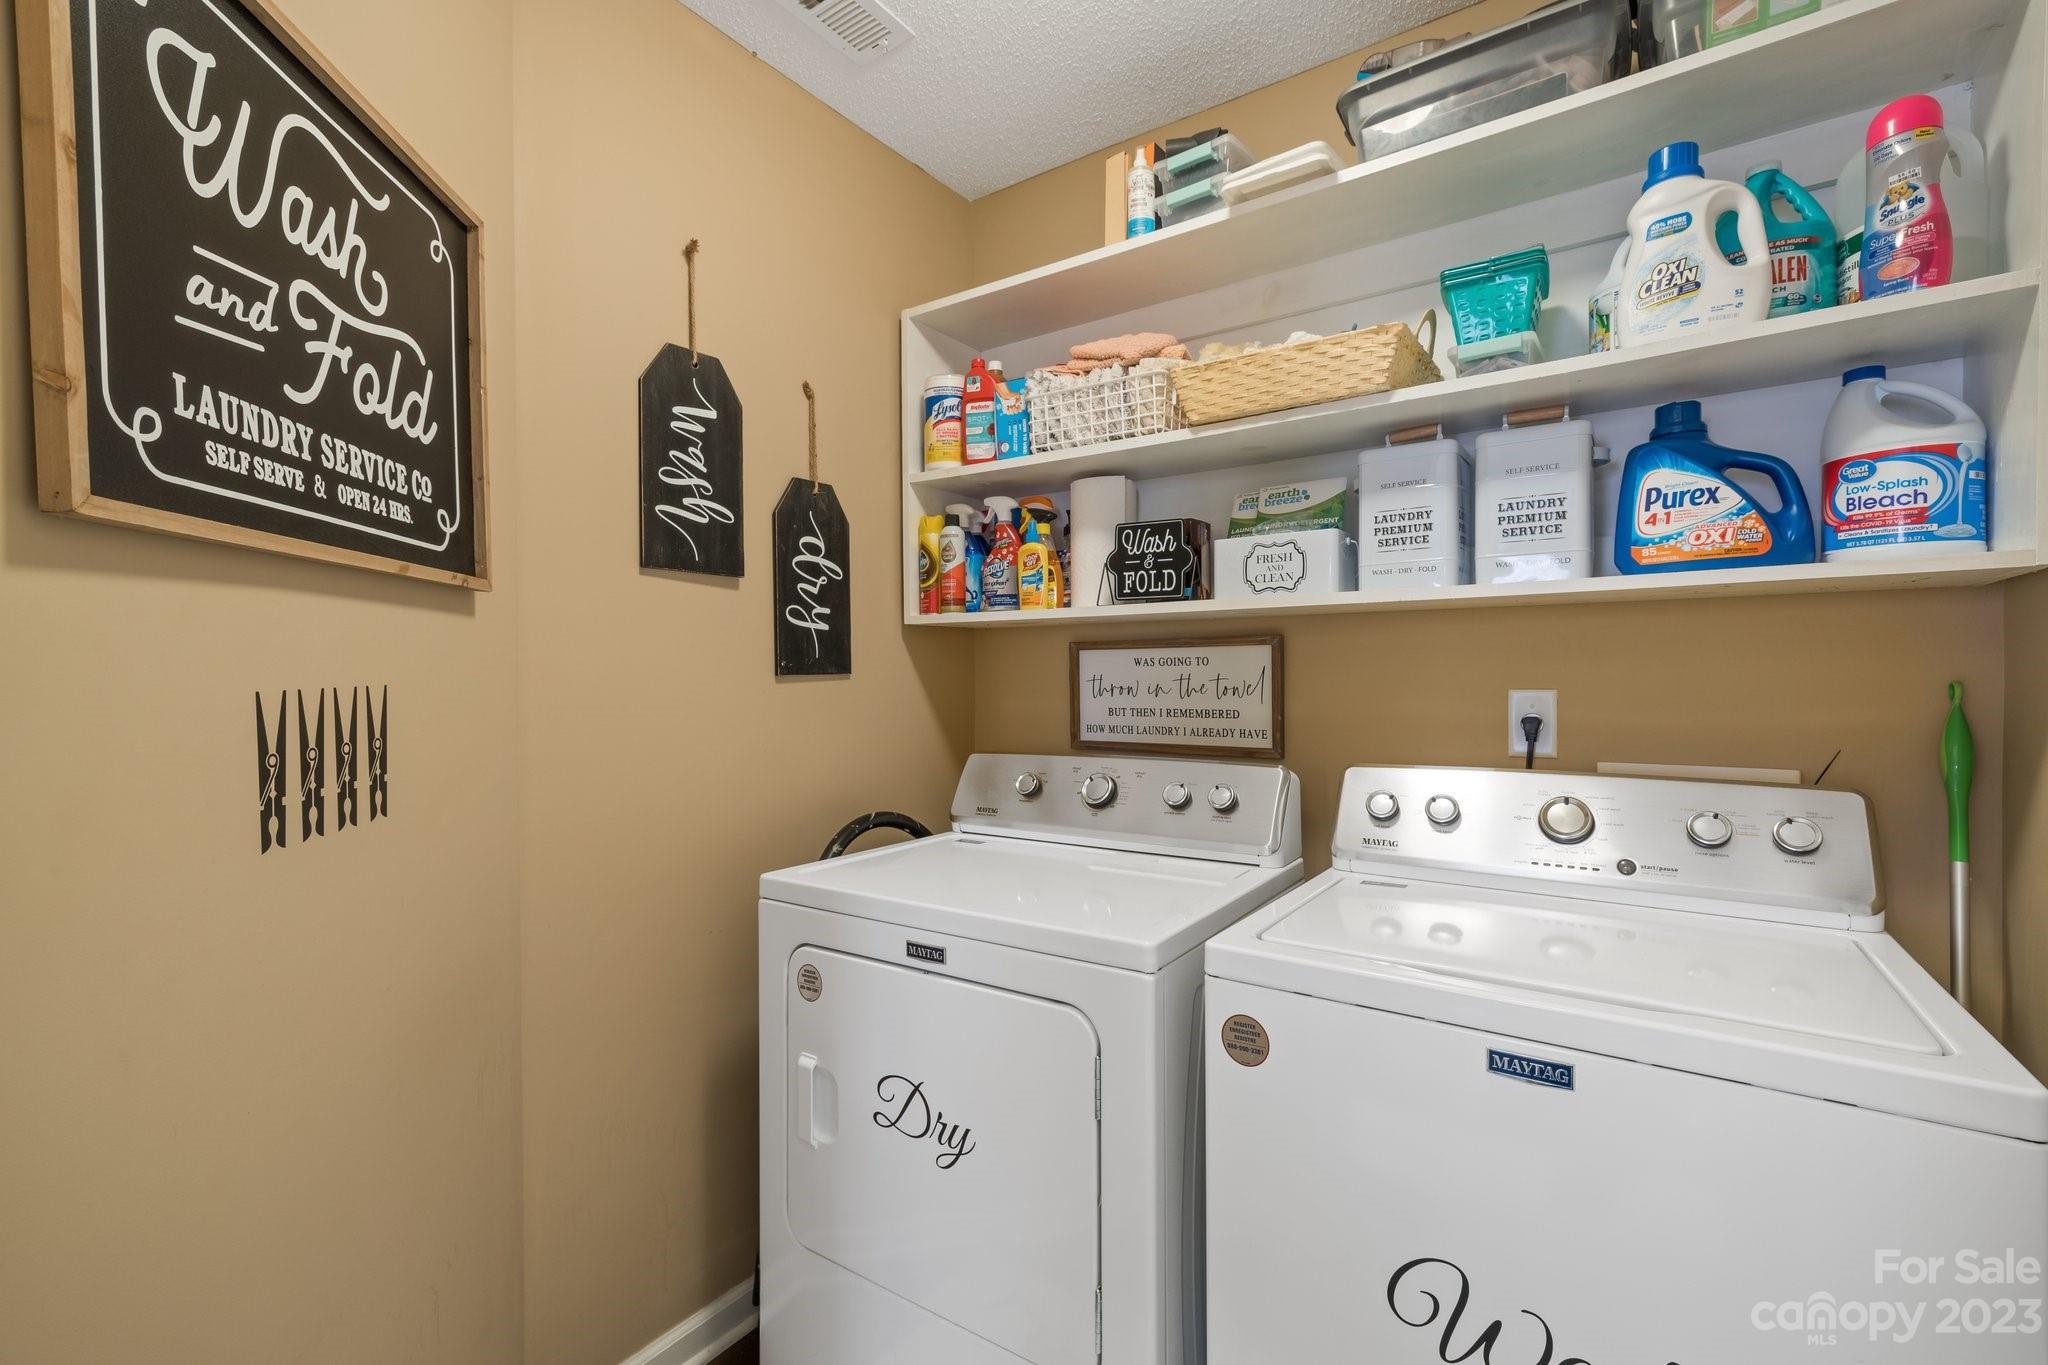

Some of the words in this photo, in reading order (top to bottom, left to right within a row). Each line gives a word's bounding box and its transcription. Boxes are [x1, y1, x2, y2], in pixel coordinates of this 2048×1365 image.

[146, 27, 390, 317] Wash
[1880, 195, 1925, 223] Snugle
[1869, 232, 1899, 251] Supe
[1652, 257, 1688, 281] OXI
[1638, 265, 1699, 300] CLEAN
[186, 273, 280, 333] and
[283, 278, 439, 446] Fold
[933, 400, 962, 419] Lysol
[172, 371, 314, 462] LAUNDRY
[320, 433, 409, 496] SERVICE
[654, 378, 735, 561] wash
[1504, 466, 1523, 476] SELF
[1525, 462, 1561, 474] SERVICE
[1842, 464, 1869, 476] Great
[1847, 471, 1869, 480] Value
[204, 440, 251, 476] SELF
[253, 456, 306, 492] SERVE
[314, 473, 327, 499] &
[337, 483, 371, 513] OPEN
[371, 495, 388, 517] 24
[389, 499, 414, 525] HRS.
[1380, 482, 1396, 490] SELF
[1397, 478, 1428, 488] SERVICE
[1845, 475, 1928, 496] Low-Splash
[1242, 496, 1260, 505] ear
[1264, 494, 1304, 508] breeze
[1268, 487, 1301, 500] earth
[1644, 485, 1721, 512] Purex
[1845, 488, 1928, 513] Bleach
[1238, 502, 1260, 512] bre
[1497, 496, 1568, 513] LAUNDRY
[1374, 509, 1434, 525] LAUNDRY
[1497, 510, 1567, 526] PREMIUM
[1644, 512, 1658, 527] 4
[1664, 511, 1672, 525] 1
[1860, 519, 1893, 528] COVID-19
[1373, 522, 1434, 537] PREMIUM
[1501, 523, 1563, 538] SERVICE
[1695, 521, 1738, 530] ADVANCED
[1870, 527, 1899, 535] Sanitizes
[1121, 528, 1177, 556] Wash
[1377, 534, 1430, 548] SERVICE
[1687, 527, 1736, 546] OXI
[1737, 533, 1763, 541] WATER
[1255, 551, 1294, 564] FRESH
[1641, 547, 1657, 557] 85
[985, 560, 1010, 578] RESOLVE
[1143, 553, 1155, 569] &
[1266, 563, 1285, 571] AND
[1254, 571, 1296, 584] CLEAN
[1371, 567, 1393, 577] WASH
[1398, 566, 1415, 575] DRY
[1418, 565, 1437, 574] FOLD
[785, 510, 844, 659] dry
[1123, 568, 1177, 594] FOLD
[1133, 657, 1155, 667] WAS
[1158, 656, 1193, 668] GOING
[1194, 656, 1210, 667] TO
[1086, 673, 1140, 700] throw
[1147, 683, 1173, 699] in
[1173, 672, 1209, 700] the
[1208, 665, 1266, 705] towel
[1108, 707, 1129, 718] BUT
[1130, 707, 1157, 718] THEN
[1165, 707, 1241, 720] REMEMBERED
[1086, 724, 1106, 734] HOW
[1108, 724, 1134, 735] MUCH
[1136, 725, 1181, 737] LAUNDRY
[1189, 727, 1237, 739] ALREADY
[1238, 728, 1269, 740] HAVE
[1361, 837, 1399, 848] MAYTAG
[1640, 864, 1679, 873] start/pause
[907, 941, 944, 962] MAYTAG
[1490, 1053, 1570, 1085] MAYTAG
[872, 1074, 977, 1170] Dry
